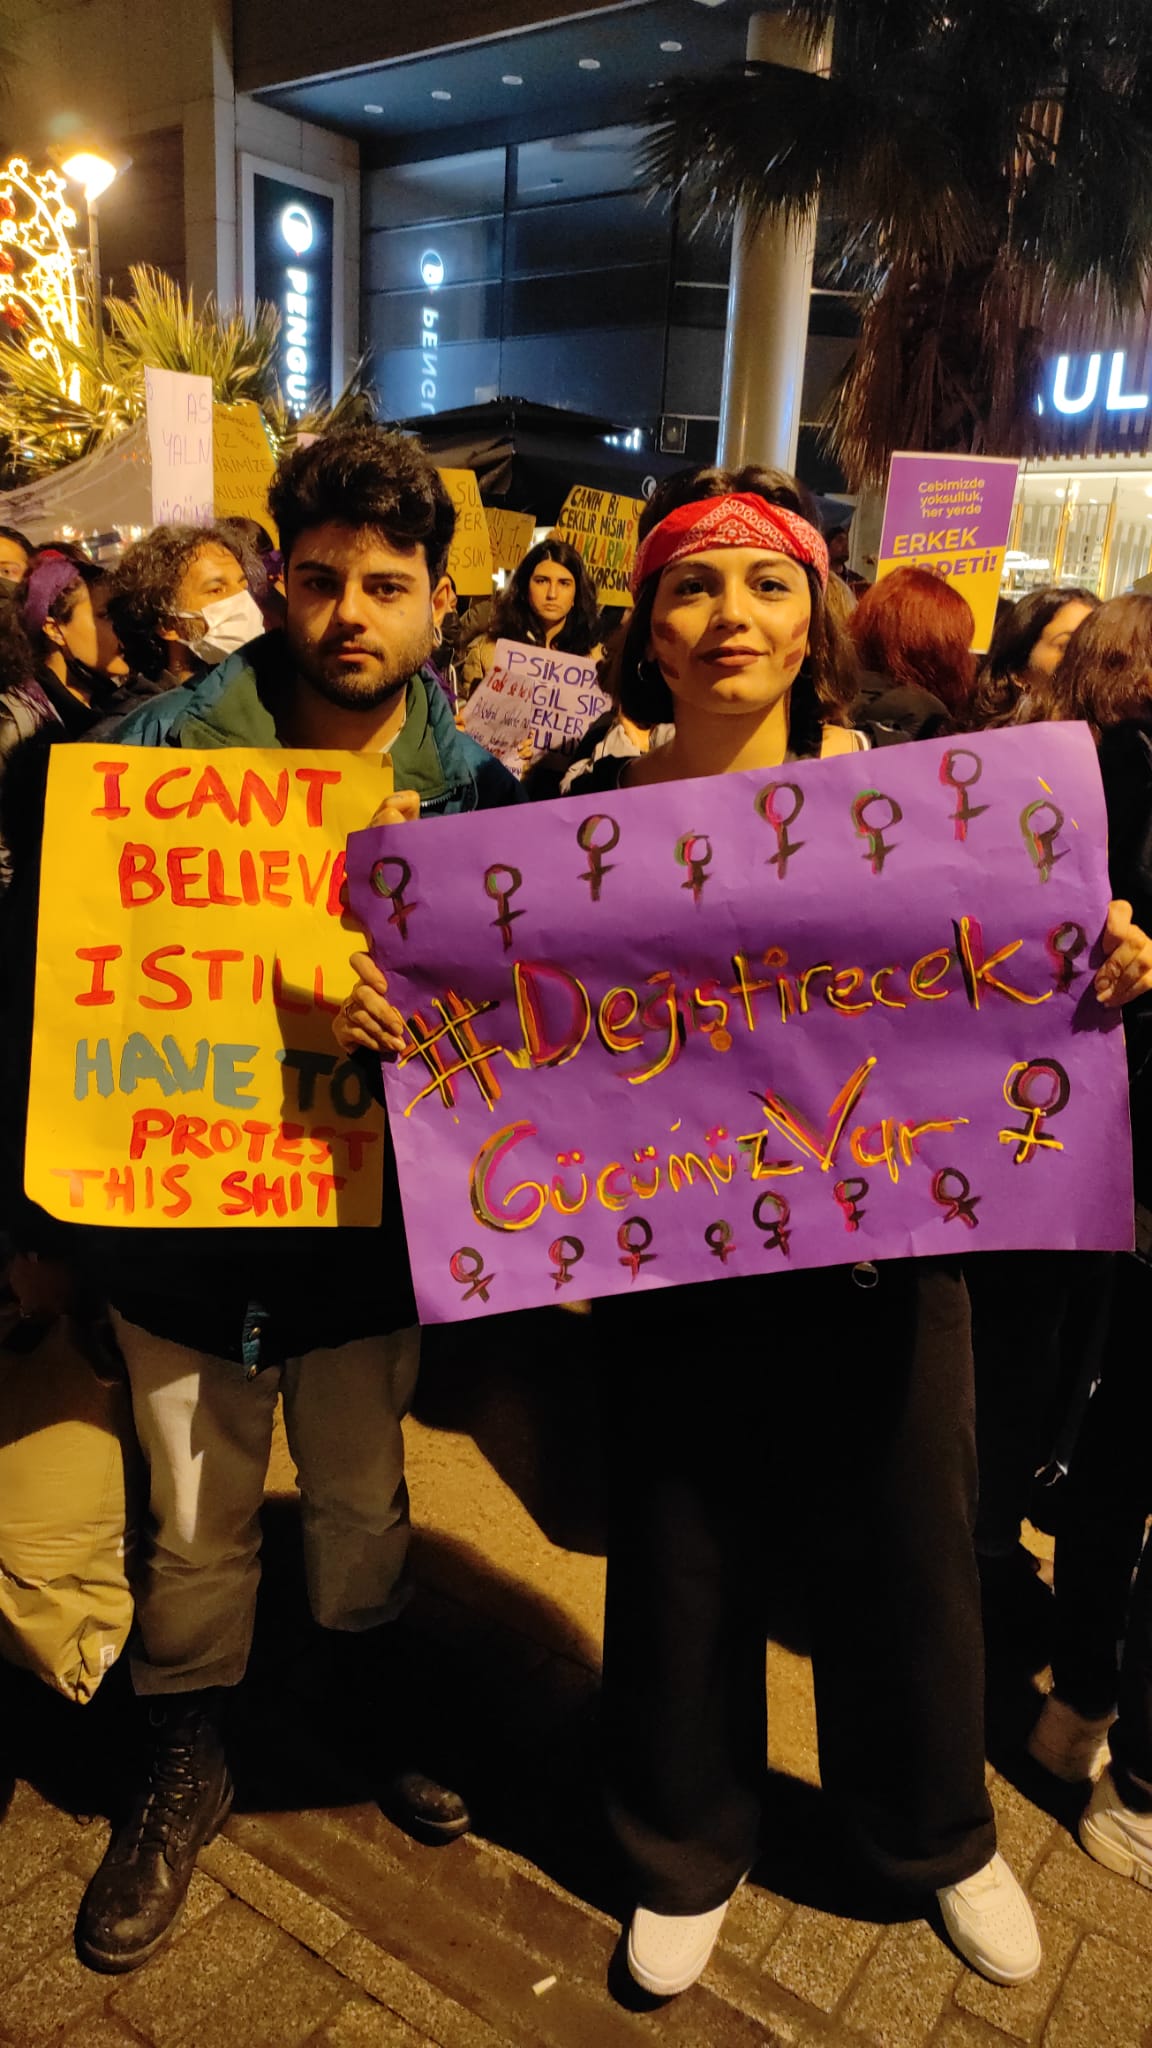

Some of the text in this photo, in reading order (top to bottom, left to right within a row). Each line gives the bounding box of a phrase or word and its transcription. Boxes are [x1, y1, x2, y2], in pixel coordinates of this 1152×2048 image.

[1038, 352, 1148, 415] UL
[918, 477, 985, 494] Cebimizde
[920, 490, 984, 508] yoksulluk,
[922, 504, 982, 519] her yerde
[893, 526, 980, 555] ERKEK
[895, 550, 998, 577] DETİ!
[91, 761, 342, 828] I CANT
[74, 944, 342, 1015] I STILL
[74, 1032, 373, 1119] HAVE TO
[130, 1108, 379, 1172] PROTEST
[748, 1056, 969, 1186] Var
[49, 1164, 347, 1218] THIS SHIT
